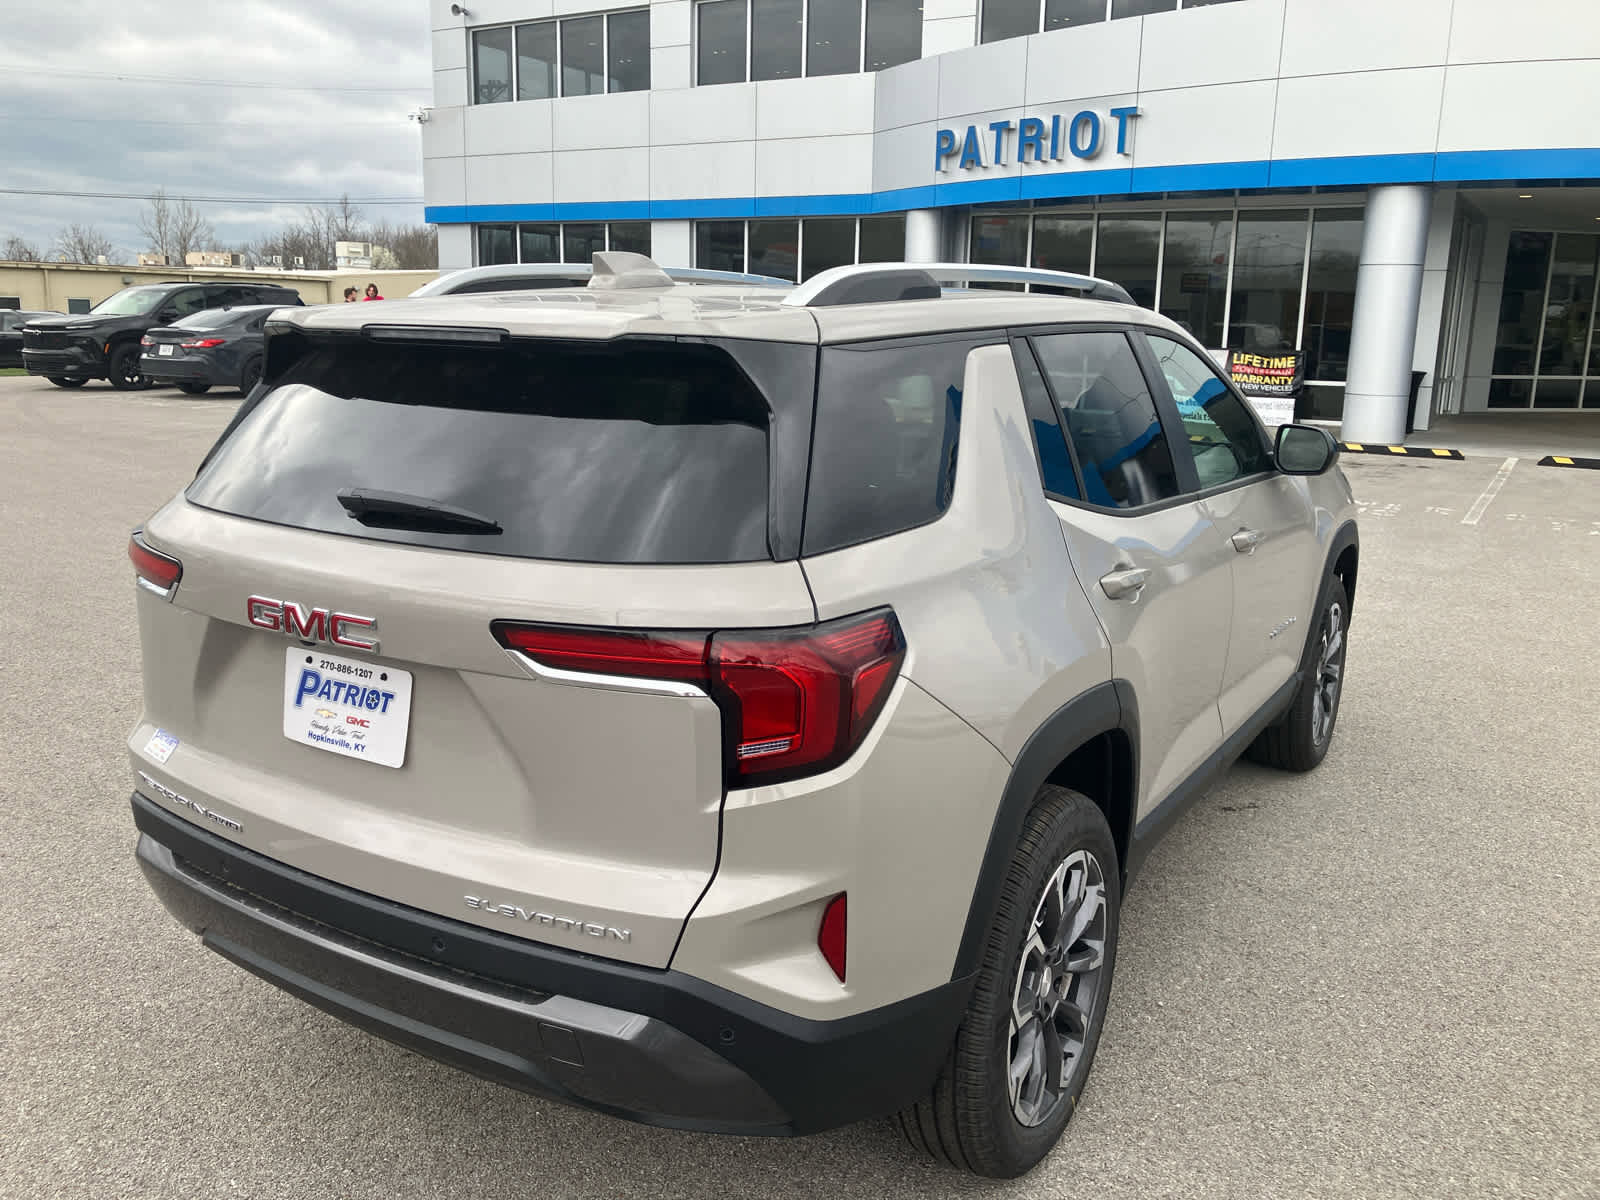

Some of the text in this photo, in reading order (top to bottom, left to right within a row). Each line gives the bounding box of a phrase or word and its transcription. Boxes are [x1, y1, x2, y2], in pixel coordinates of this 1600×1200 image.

[936, 106, 1140, 171] PATRIOT
[1233, 352, 1296, 369] LIFETIME
[1232, 373, 1294, 385] WARRANTY
[1241, 383, 1260, 391] NEW
[247, 595, 380, 655] GMC
[320, 659, 373, 680] 270-886-1207
[295, 668, 395, 713] PATRIOT
[345, 715, 371, 728] GMC
[307, 730, 366, 752] Hopkinsville, KY
[464, 894, 632, 943] ELEVATION
